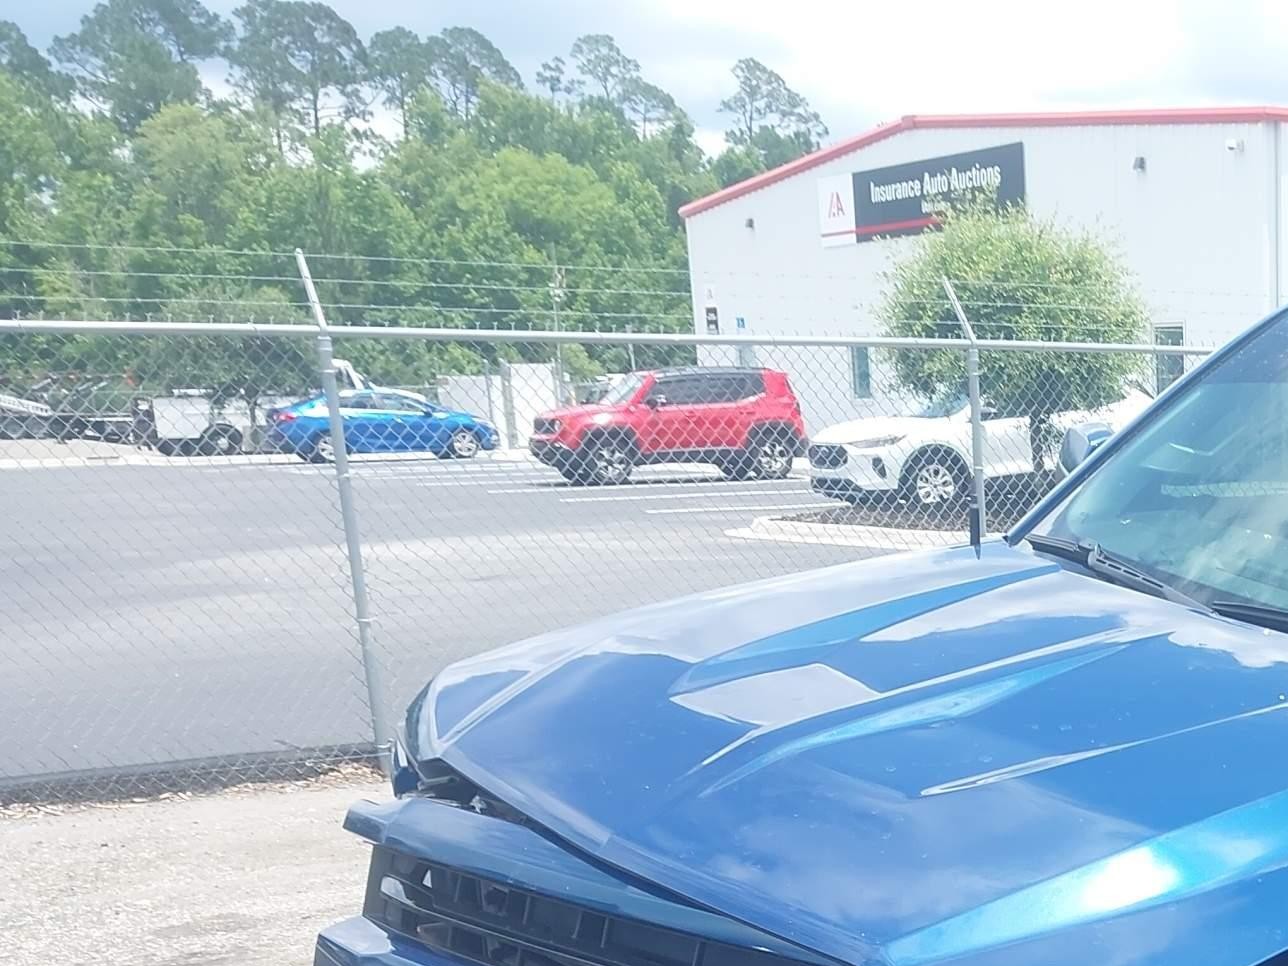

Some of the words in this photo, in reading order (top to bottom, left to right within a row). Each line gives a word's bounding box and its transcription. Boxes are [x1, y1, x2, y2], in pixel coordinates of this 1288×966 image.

[870, 179, 921, 204] Insurance
[922, 171, 948, 195] Auto
[949, 163, 1001, 188] Auctions
